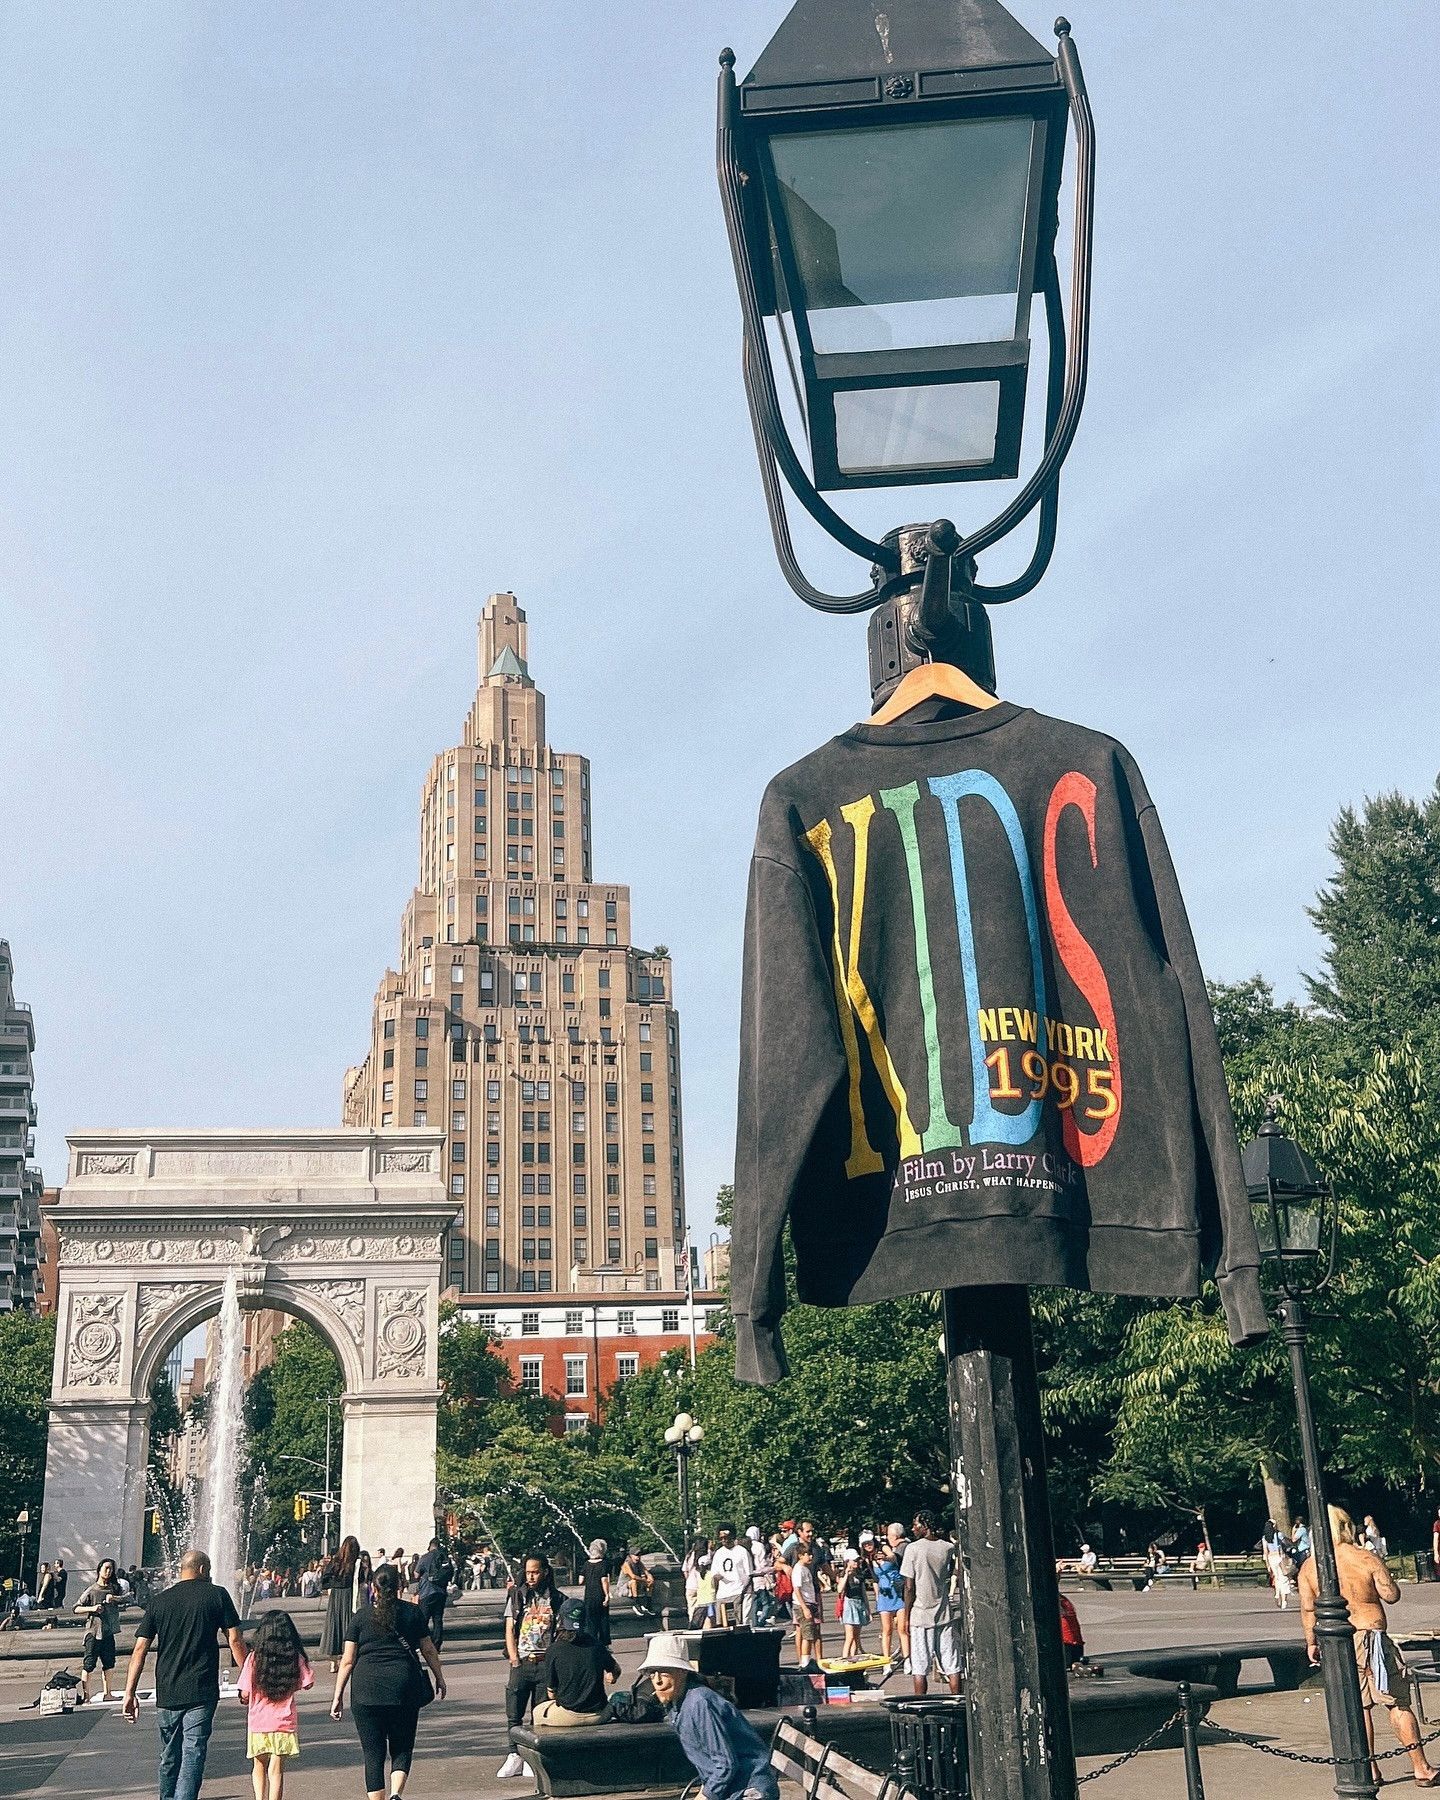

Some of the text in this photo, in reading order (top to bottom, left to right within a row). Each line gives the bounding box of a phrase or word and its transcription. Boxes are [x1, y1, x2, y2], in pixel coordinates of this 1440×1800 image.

[802, 768, 1122, 1179] KIDS
[977, 1007, 1114, 1062] NEW YORK
[983, 1046, 1121, 1120] 1995
[903, 1157, 946, 1185] Film
[951, 1151, 976, 1180] by
[981, 1148, 1037, 1178] Larry
[905, 1187, 932, 1203] JESUS
[935, 1180, 980, 1194] CHRIST,
[983, 1176, 1013, 1187] WHAT
